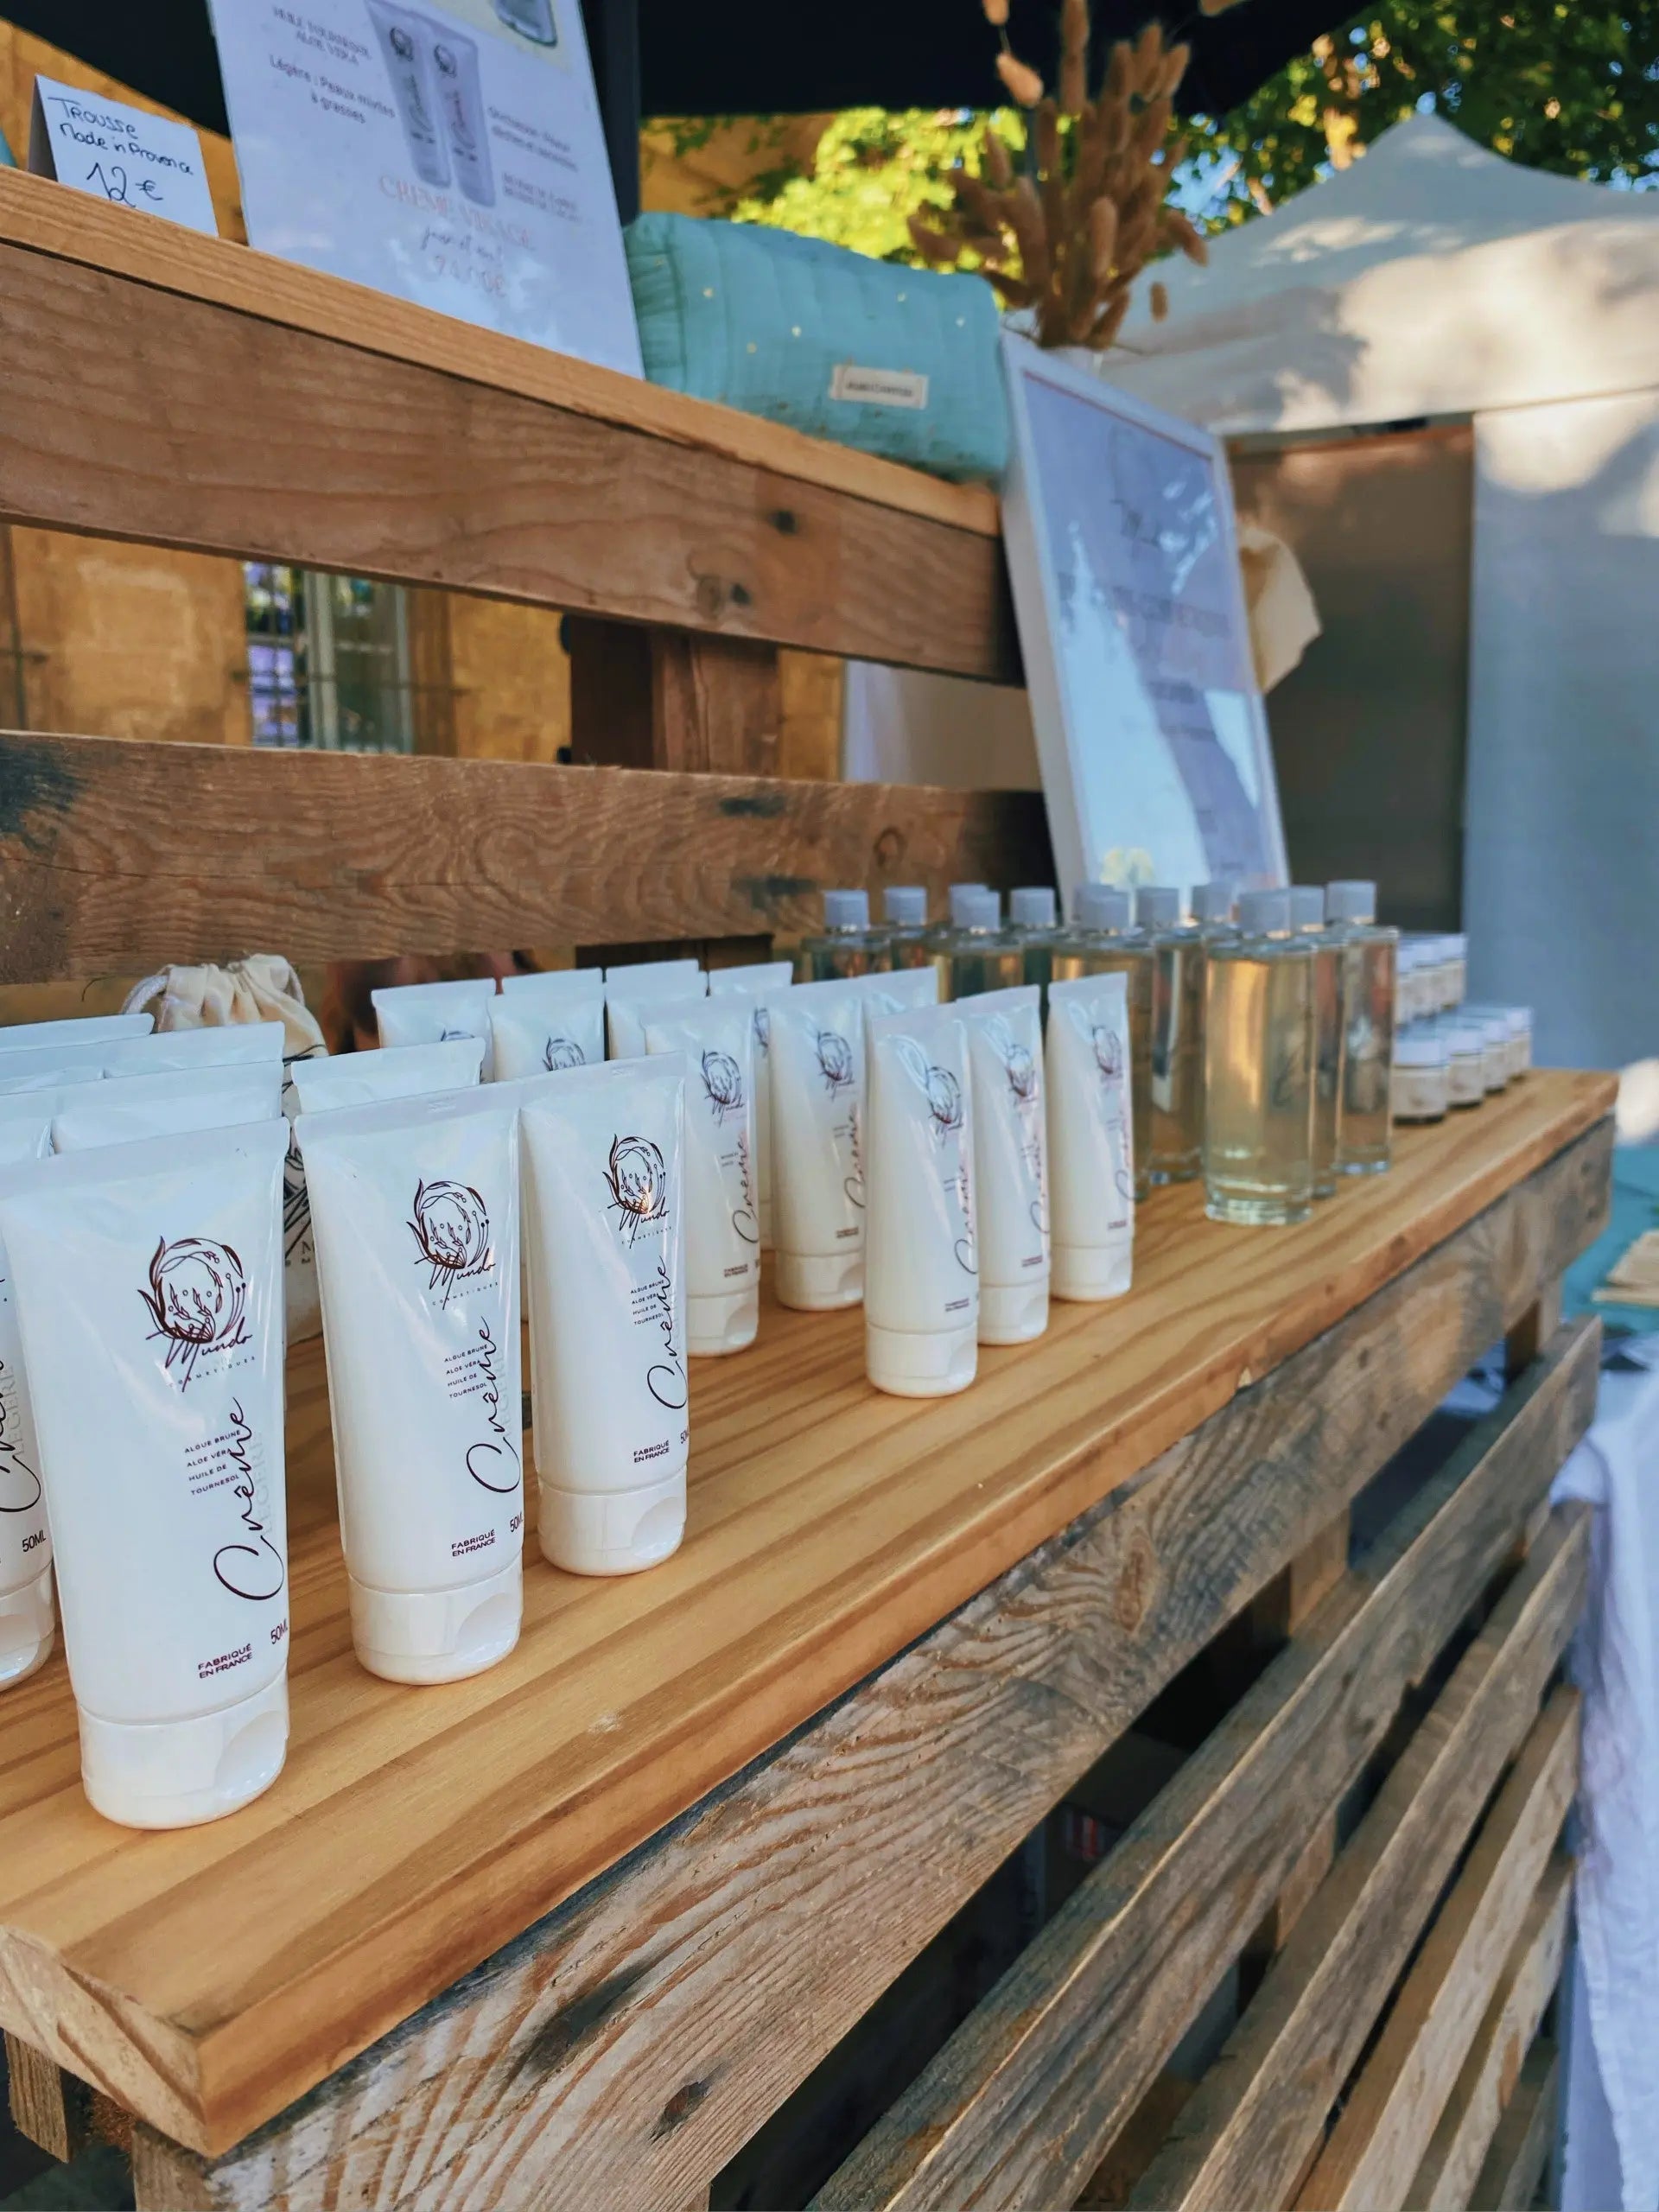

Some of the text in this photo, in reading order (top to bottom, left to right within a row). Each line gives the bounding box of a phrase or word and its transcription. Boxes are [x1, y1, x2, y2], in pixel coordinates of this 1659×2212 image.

[446, 1365, 463, 1375] ALOE
[448, 1372, 478, 1387] HUILE DE
[184, 1429, 241, 1453] ALGUE BRUNE
[187, 1455, 209, 1467] ALOE
[188, 1464, 227, 1481] HUILE DE
[191, 1473, 240, 1496] TOURNESOL
[22, 1529, 47, 1553] 50ML
[451, 1529, 495, 1550] FABRIQUÉ
[453, 1537, 496, 1557] EN FRANCE
[198, 1643, 251, 1671] FABRIQUÉ
[200, 1652, 253, 1679] EN FRANCE
